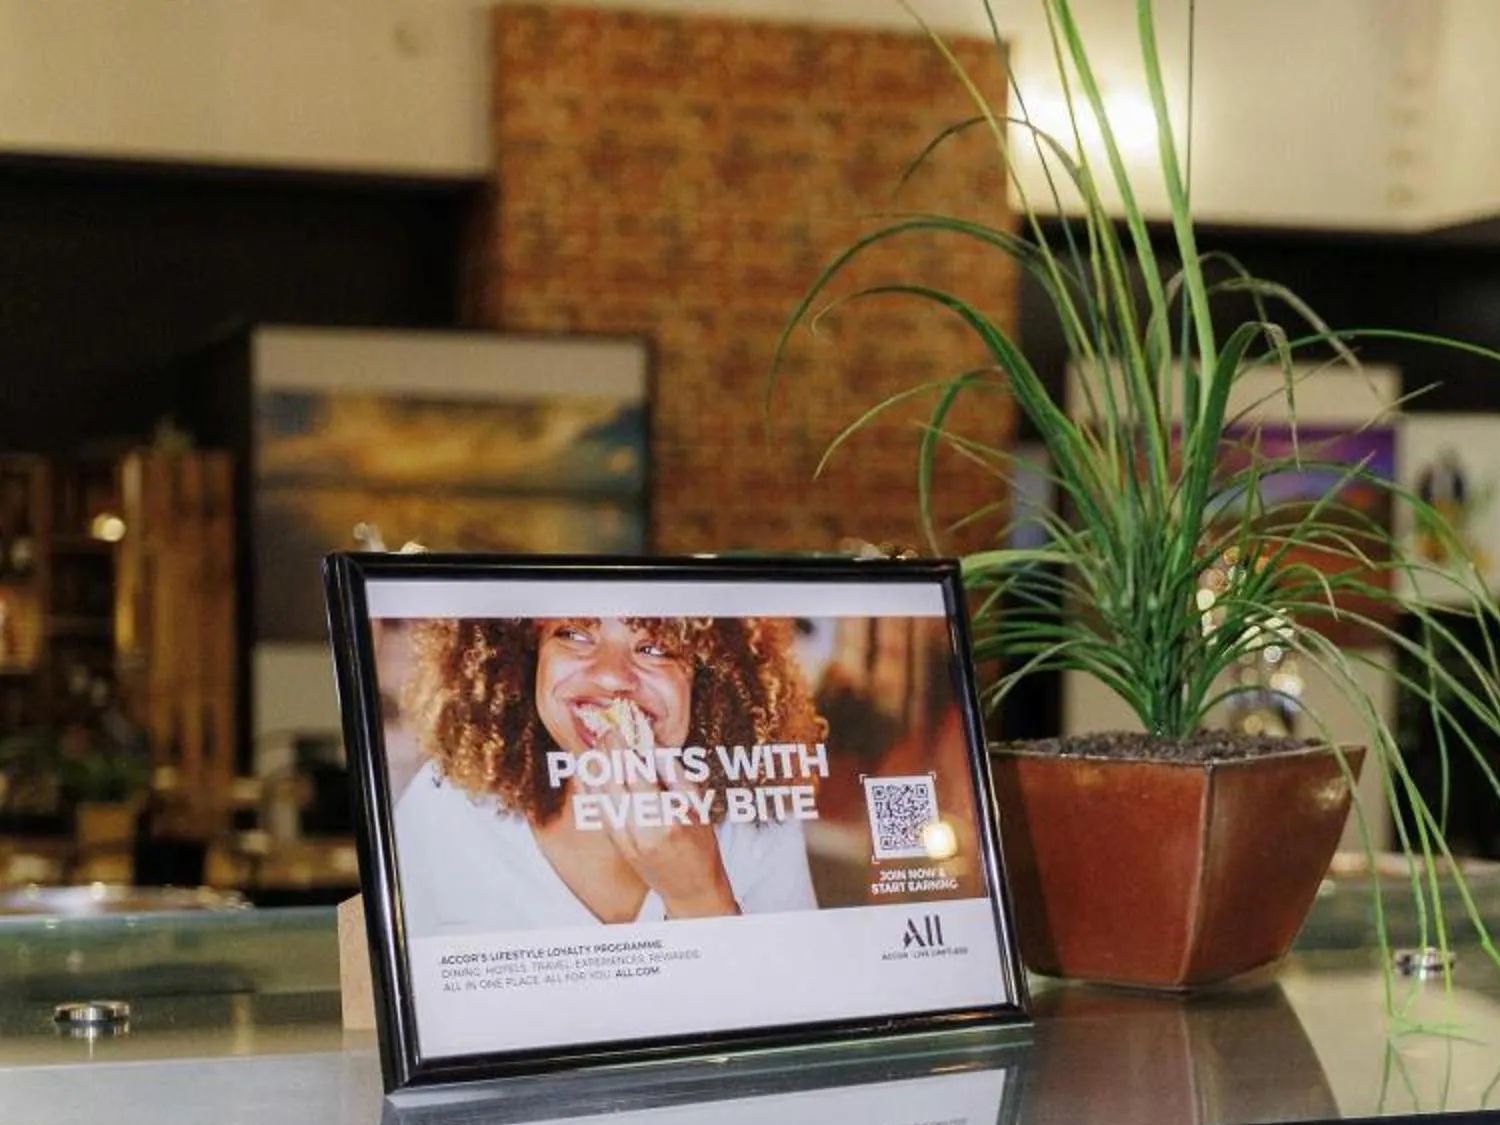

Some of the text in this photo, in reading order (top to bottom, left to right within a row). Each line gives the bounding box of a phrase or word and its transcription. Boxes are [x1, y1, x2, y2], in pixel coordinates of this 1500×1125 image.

[546, 743, 829, 788] POINTS WITH
[573, 785, 819, 831] EVERY BITE
[880, 869, 906, 881] JOIN
[908, 867, 936, 879] NOW
[871, 878, 959, 895] START EARNING
[491, 948, 544, 961] LIFESTYLE
[547, 945, 591, 957] LOYALTY
[594, 940, 663, 953] PROGRAMME
